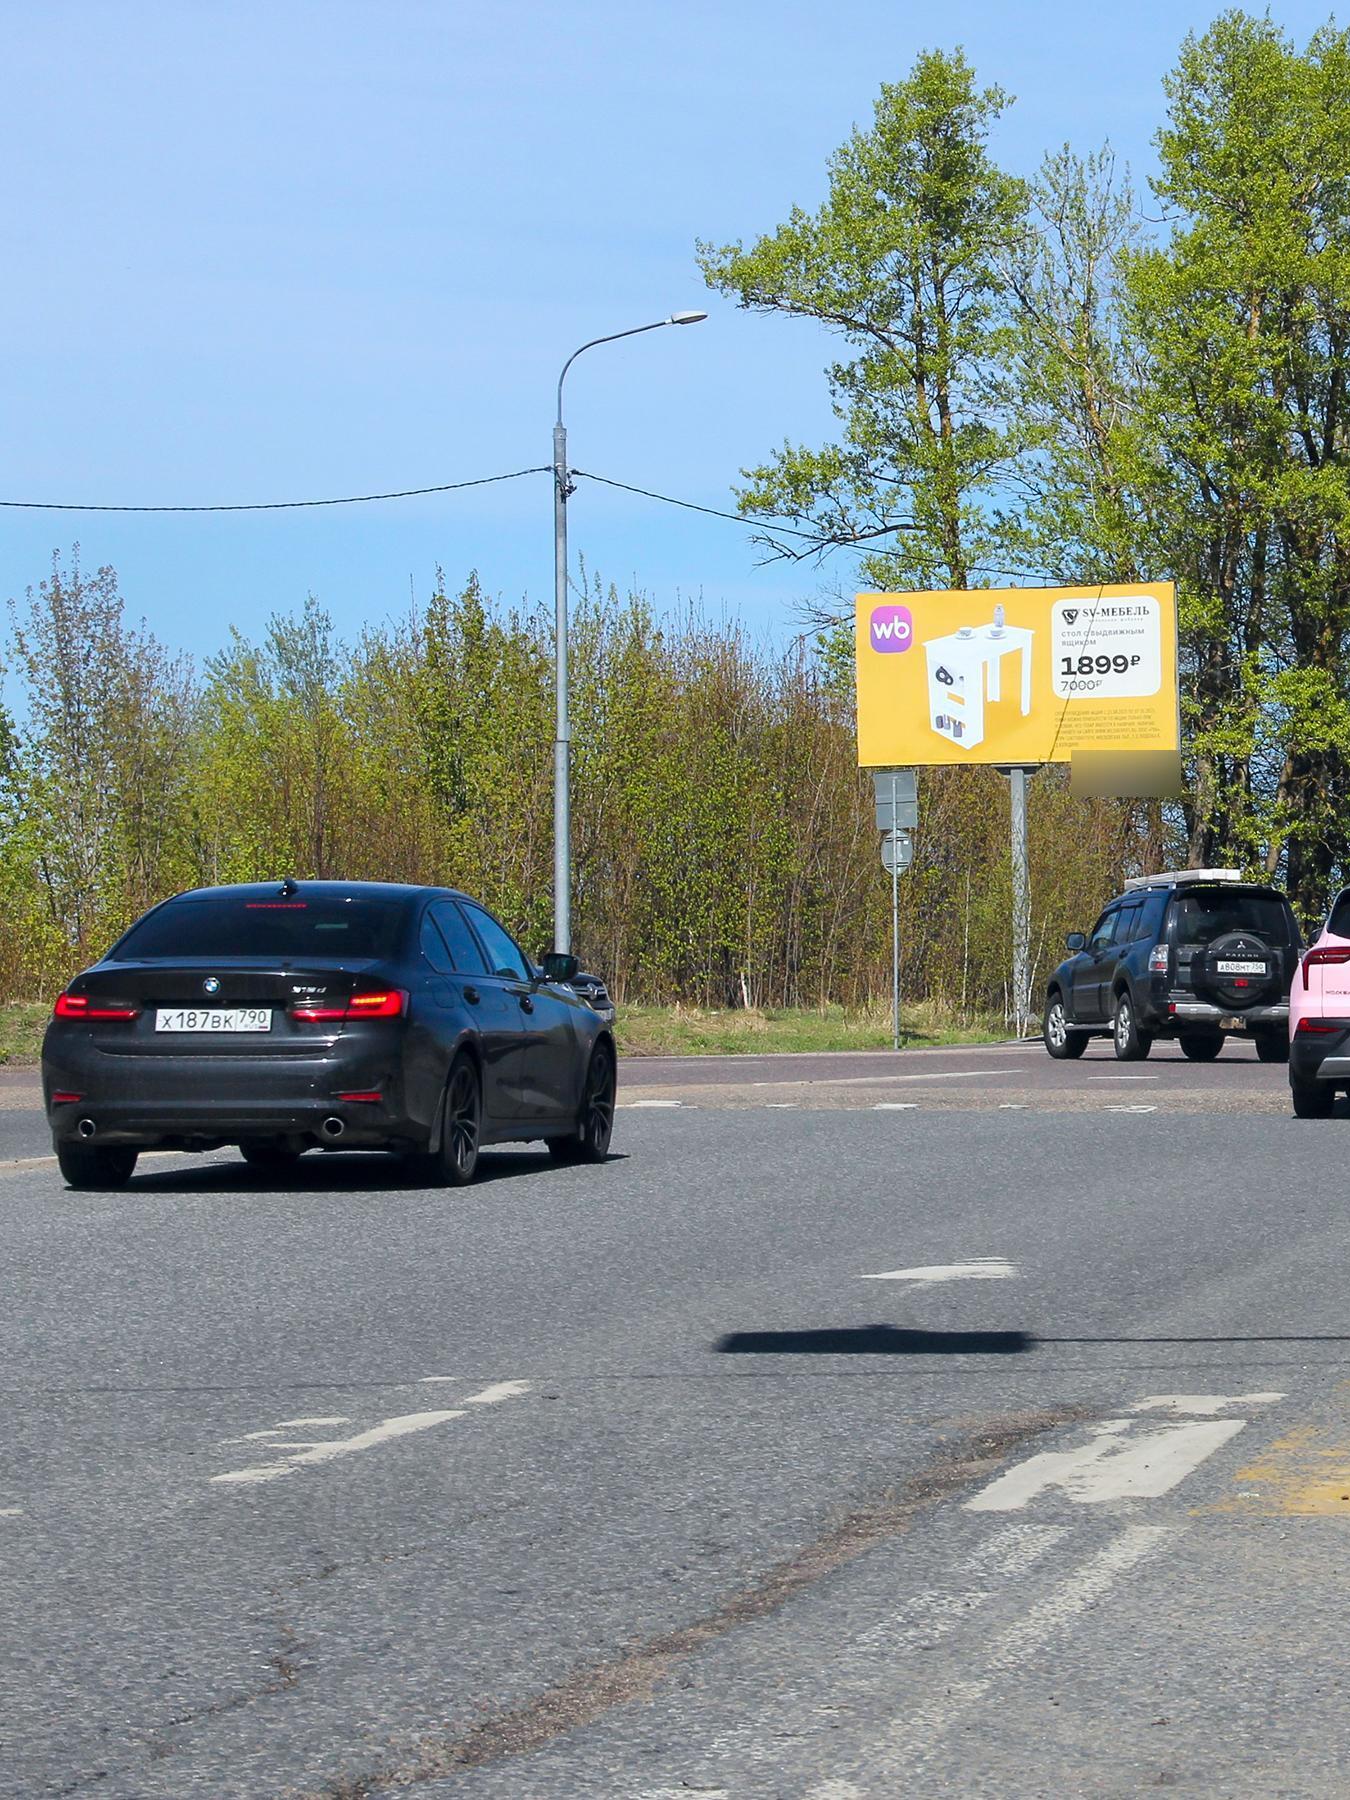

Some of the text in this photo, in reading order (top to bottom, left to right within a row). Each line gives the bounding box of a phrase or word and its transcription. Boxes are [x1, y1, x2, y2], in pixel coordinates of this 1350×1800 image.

[1082, 606, 1150, 617] SV-МЕБЕЛЬ
[872, 615, 910, 640] wb
[240, 1010, 267, 1024] 790
